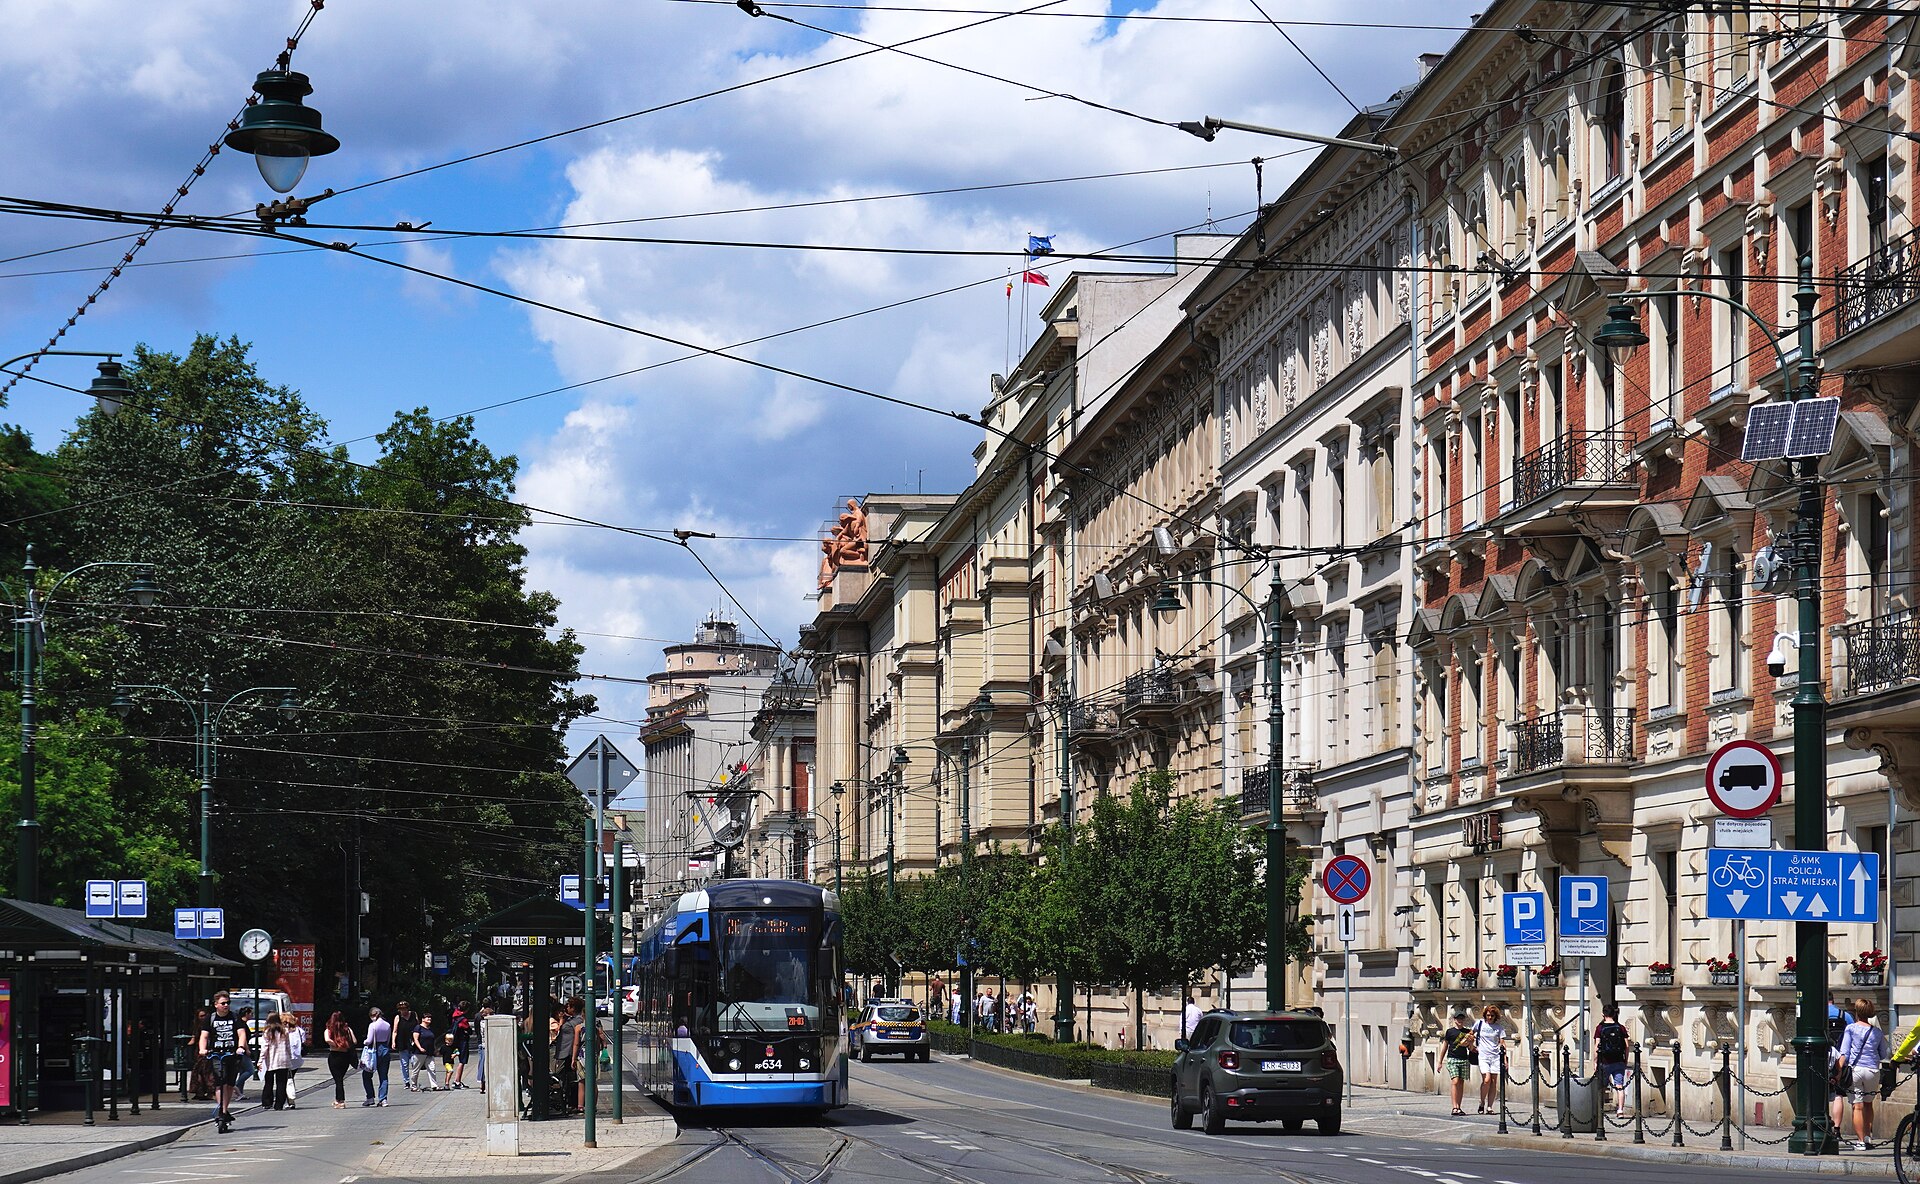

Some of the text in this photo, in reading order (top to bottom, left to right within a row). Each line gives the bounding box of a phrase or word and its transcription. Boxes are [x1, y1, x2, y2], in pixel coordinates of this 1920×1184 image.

[1801, 856, 1821, 864] KMK
[1788, 866, 1823, 875] POLICJA
[1773, 875, 1838, 886] STRAŻ MIEJSKA
[1571, 881, 1598, 918] P
[1512, 897, 1536, 929] P
[512, 937, 518, 945] 14
[521, 937, 527, 945] 20
[539, 937, 545, 945] 75
[280, 948, 300, 957] Rab
[788, 1017, 805, 1026] 20-03
[1266, 1061, 1276, 1069] KR
